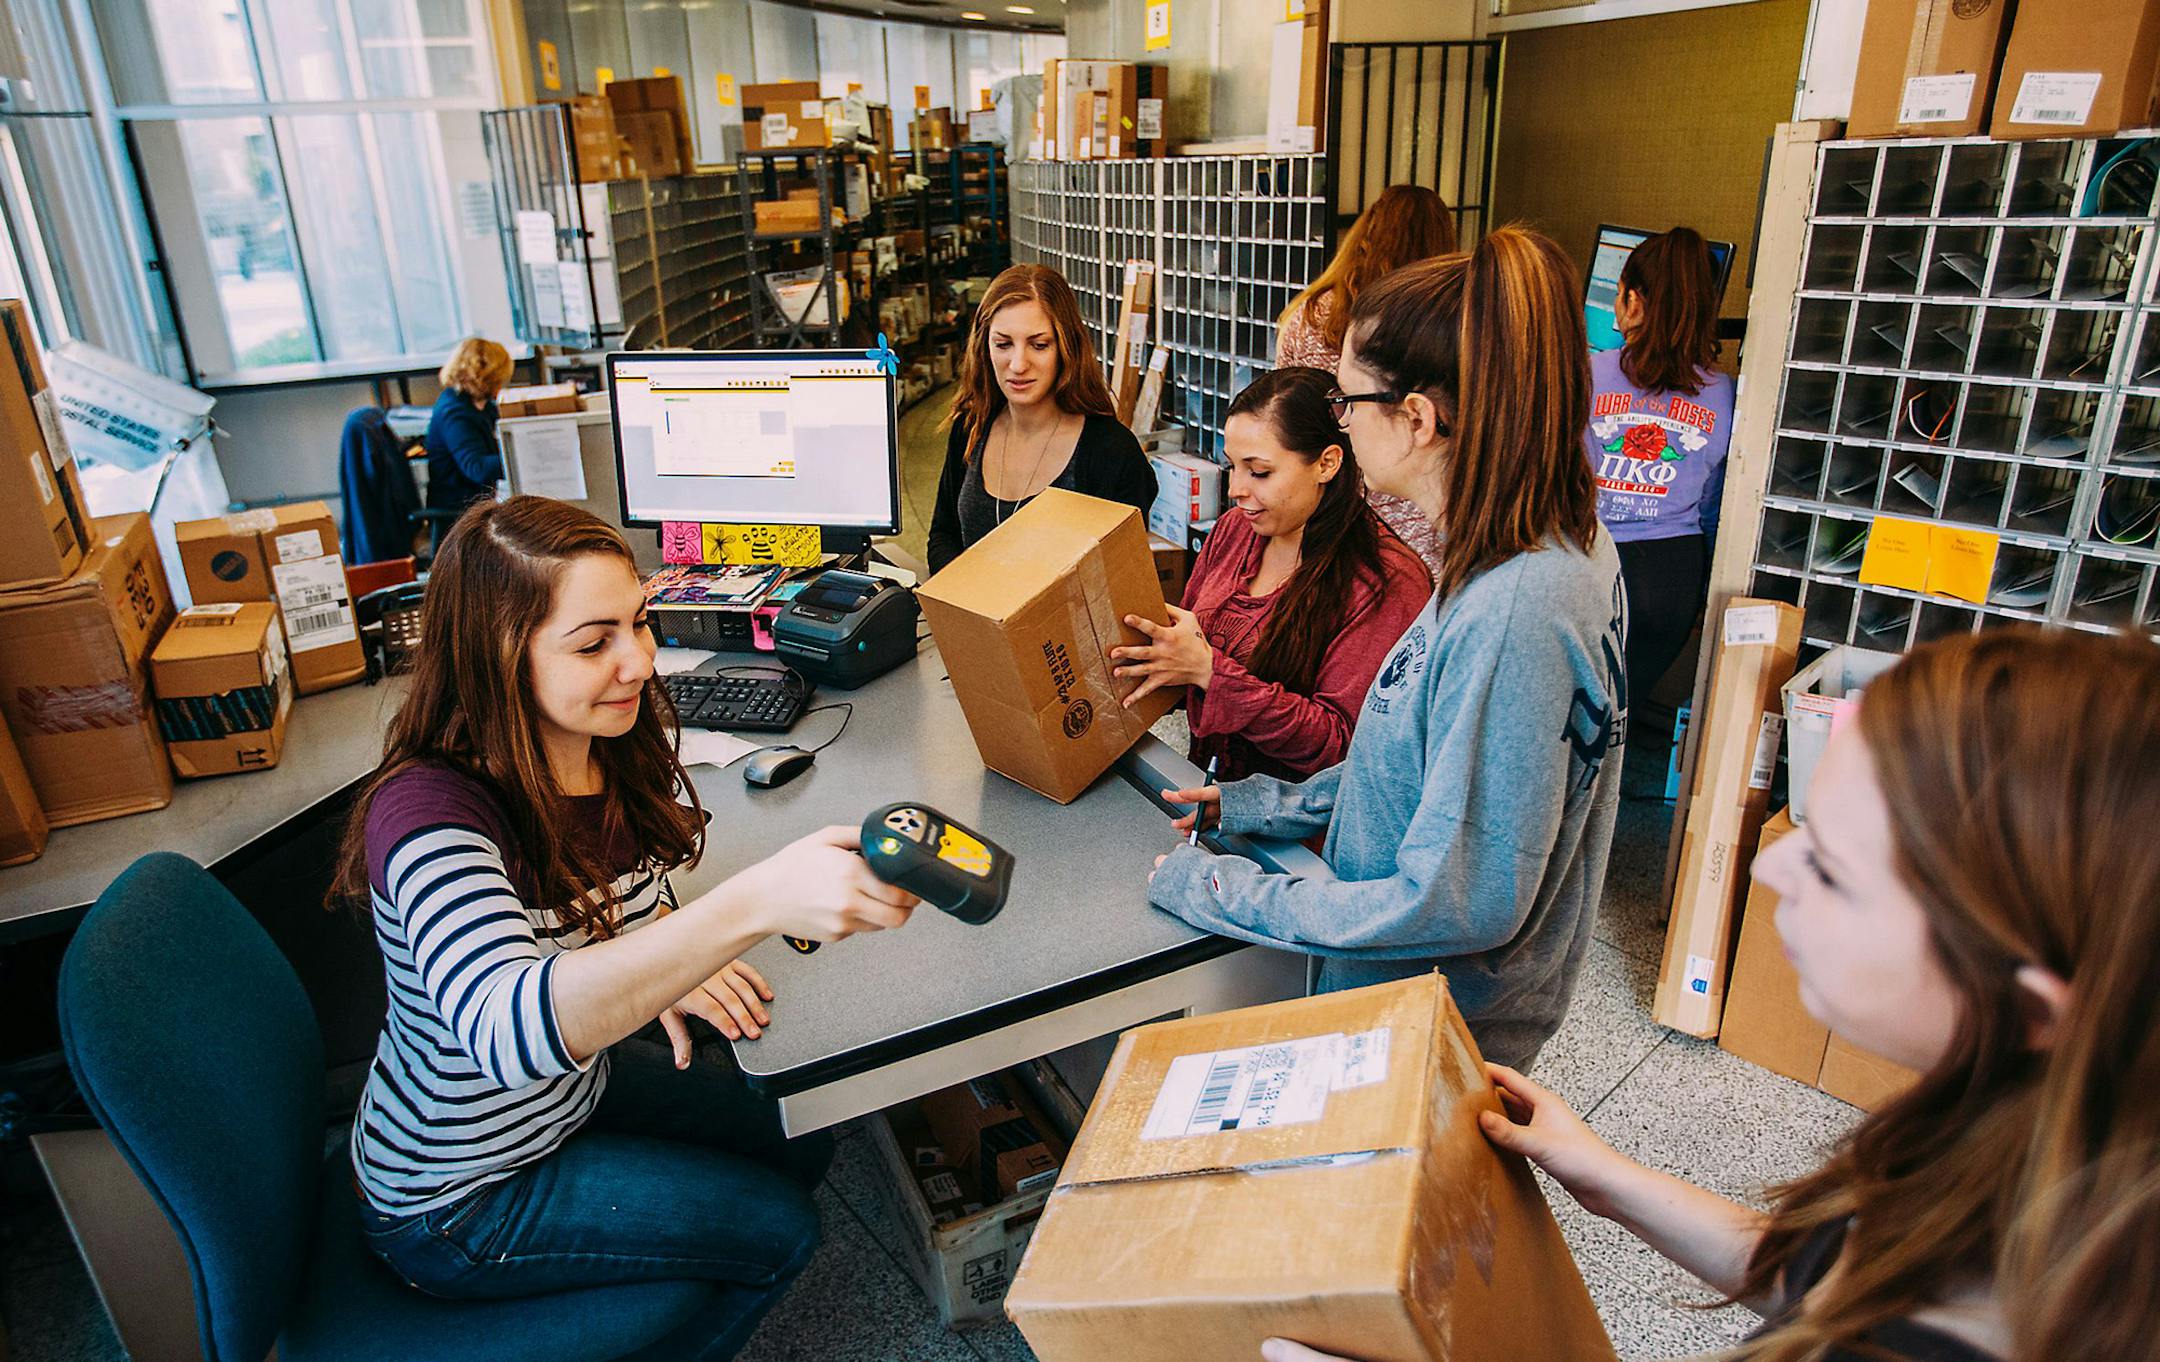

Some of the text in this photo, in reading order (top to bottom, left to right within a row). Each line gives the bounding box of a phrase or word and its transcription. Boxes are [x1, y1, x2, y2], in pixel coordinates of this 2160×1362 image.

[60, 394, 161, 441] UNITED STATES
[60, 408, 100, 431] OSTAL
[1594, 392, 1632, 416] WAR
[1667, 396, 1717, 434] ROSES
[1597, 454, 1678, 485] ΠΚΦ
[972, 1274, 1006, 1291] LABEL
